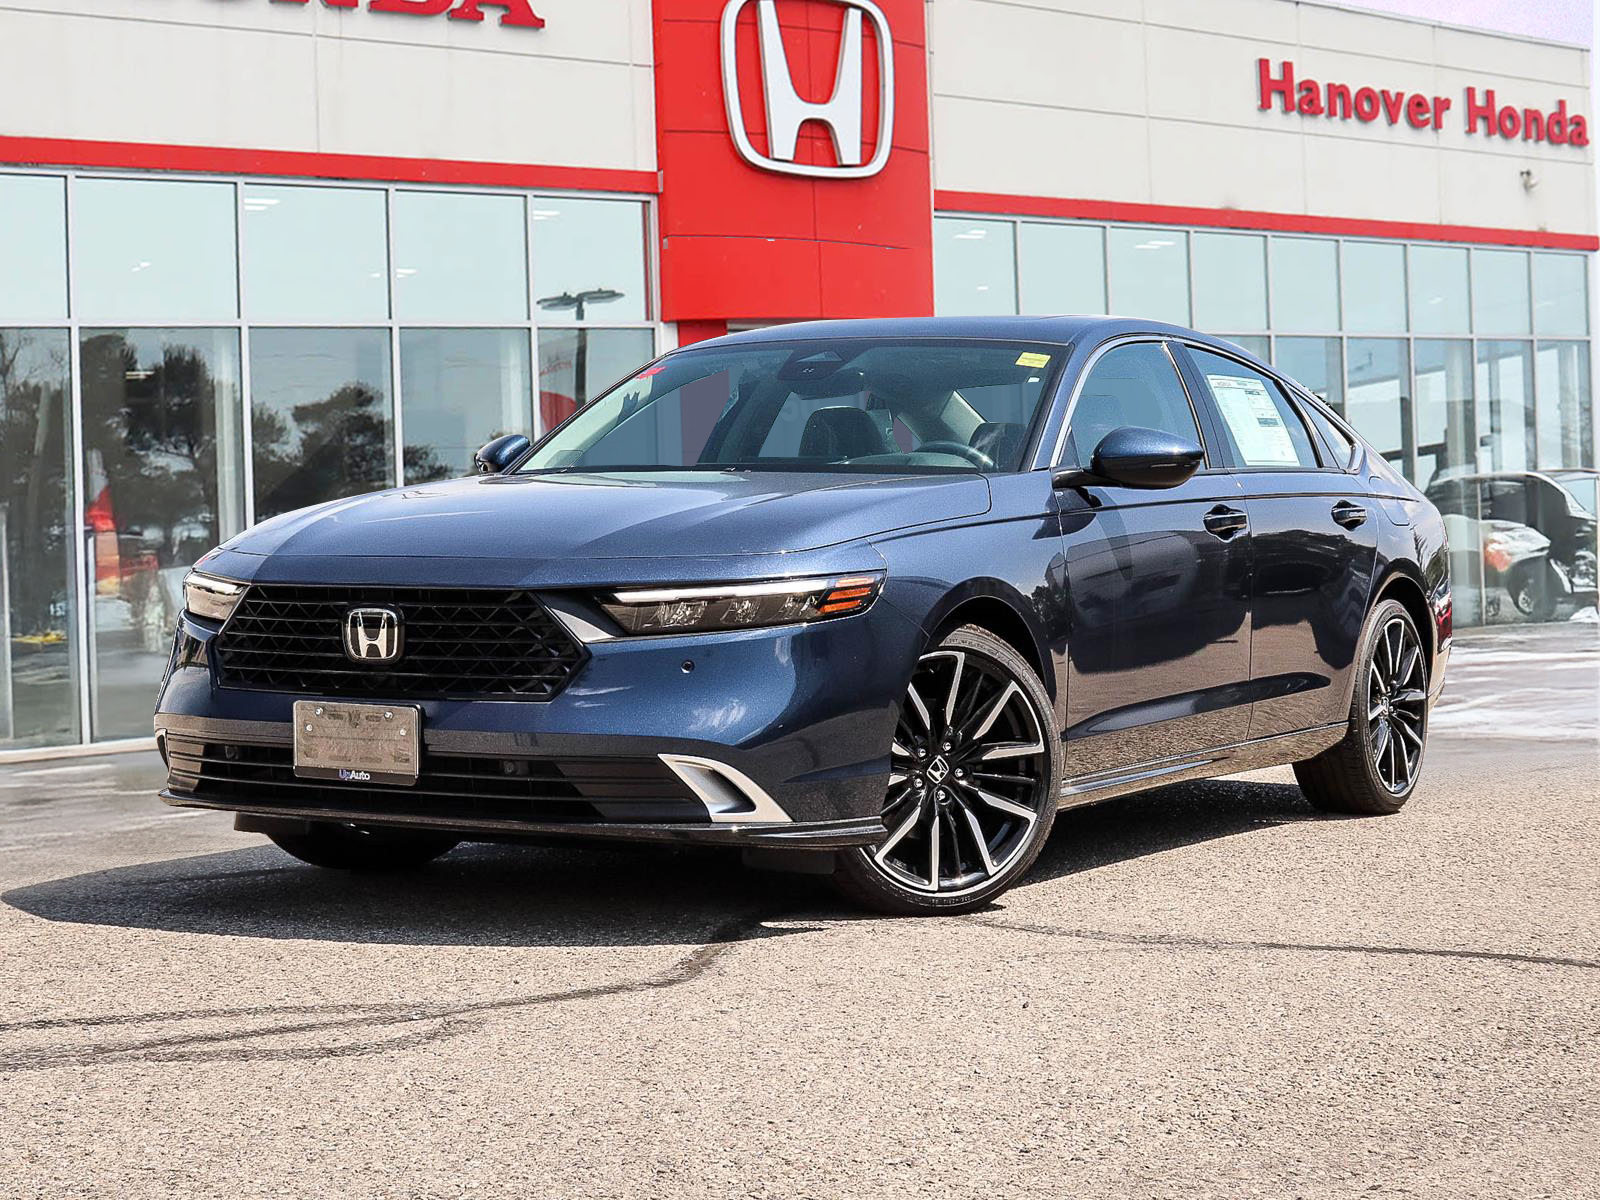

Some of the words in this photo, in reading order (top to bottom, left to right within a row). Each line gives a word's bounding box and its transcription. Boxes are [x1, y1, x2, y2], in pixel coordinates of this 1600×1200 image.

[1257, 57, 1451, 131] Hanover
[1464, 86, 1590, 148] Honda
[338, 769, 371, 781] UpAuto
